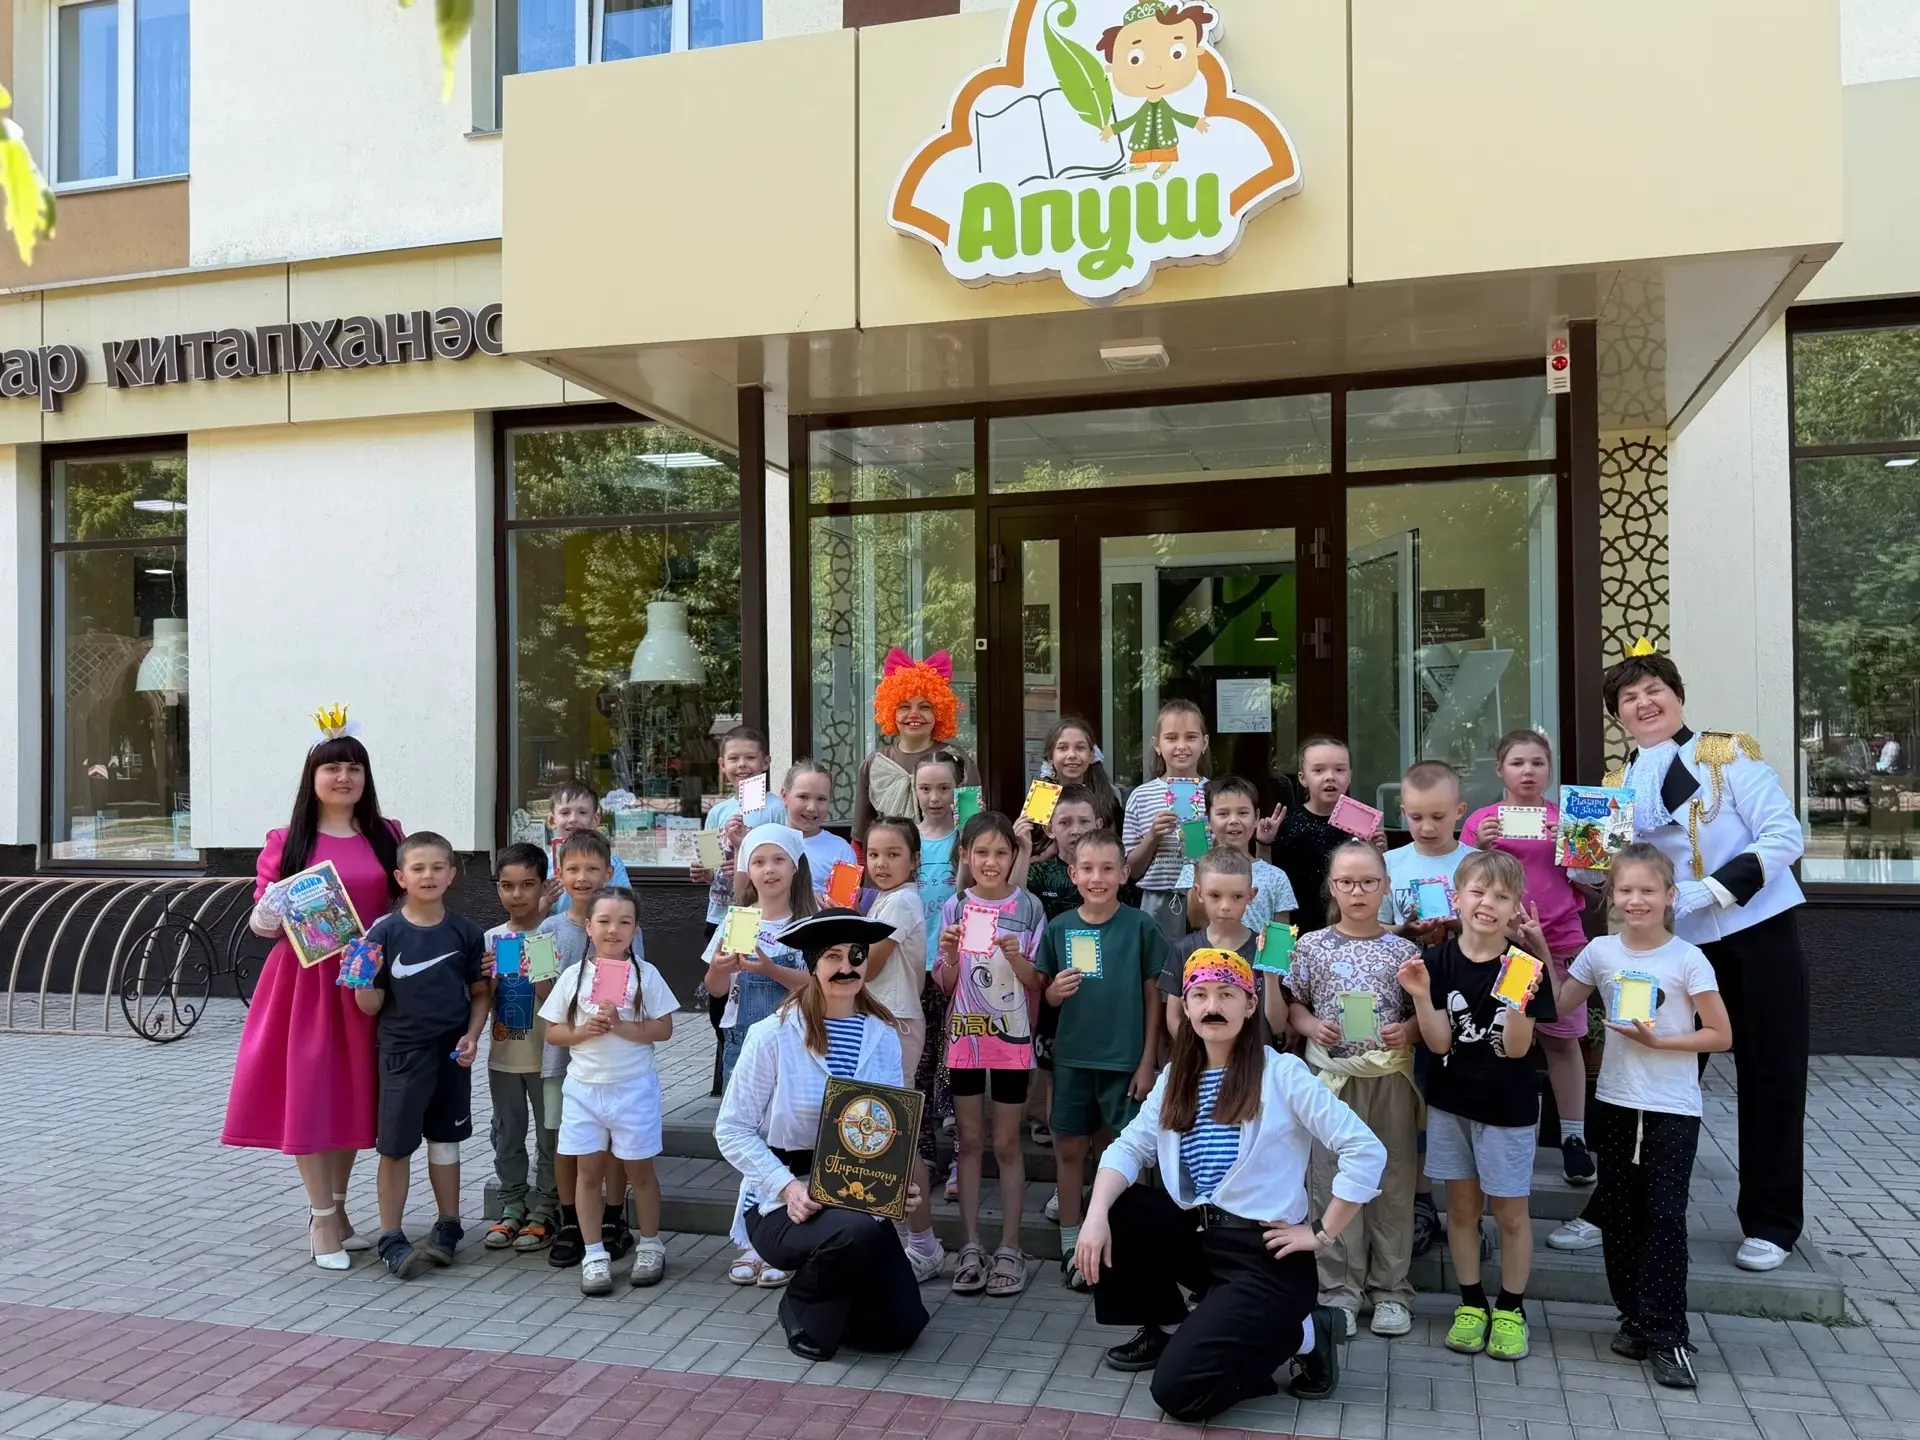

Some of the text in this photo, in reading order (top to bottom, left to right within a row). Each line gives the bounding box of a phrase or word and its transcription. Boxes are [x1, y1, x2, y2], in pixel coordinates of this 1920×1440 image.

[957, 172, 1223, 281] Апуш
[0, 343, 87, 412] ар
[825, 1148, 898, 1187] Пиратология
